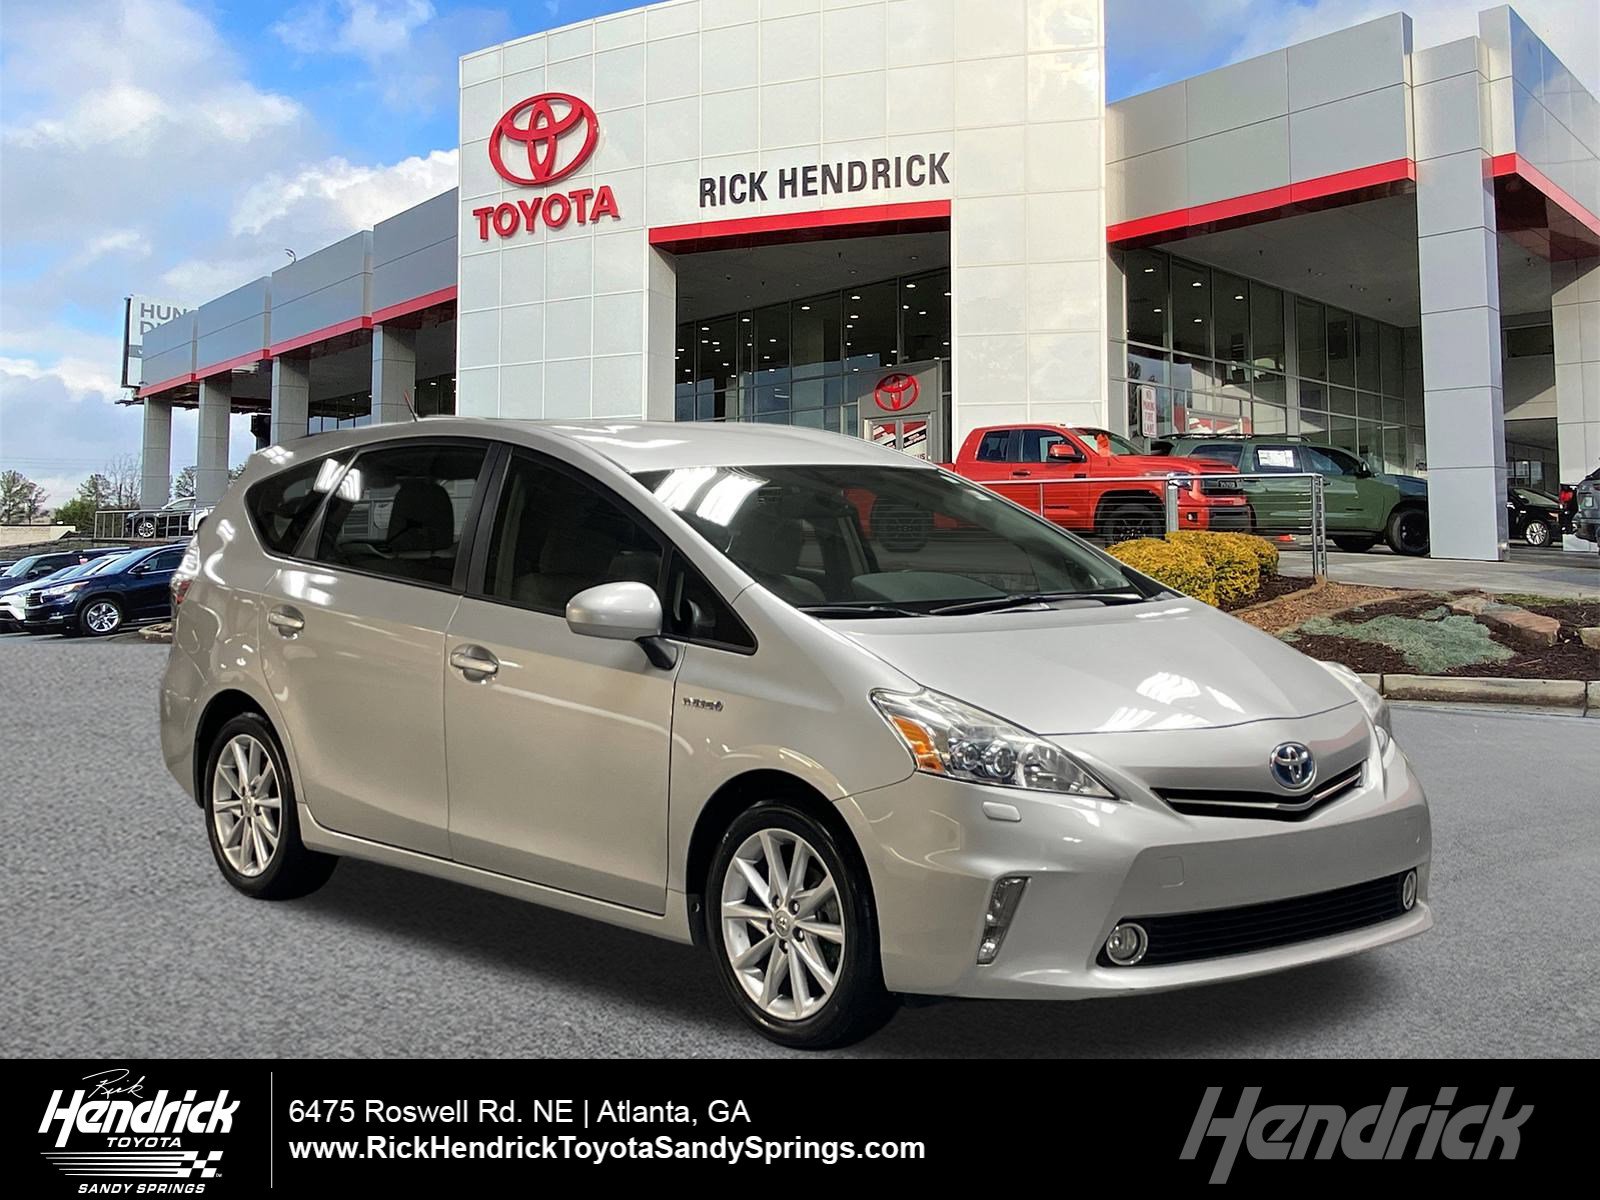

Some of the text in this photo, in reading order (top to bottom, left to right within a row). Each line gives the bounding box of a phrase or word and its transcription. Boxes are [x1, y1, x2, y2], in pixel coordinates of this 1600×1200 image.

[699, 152, 951, 208] RICK HENDRICK
[472, 185, 620, 241] TOYOTA
